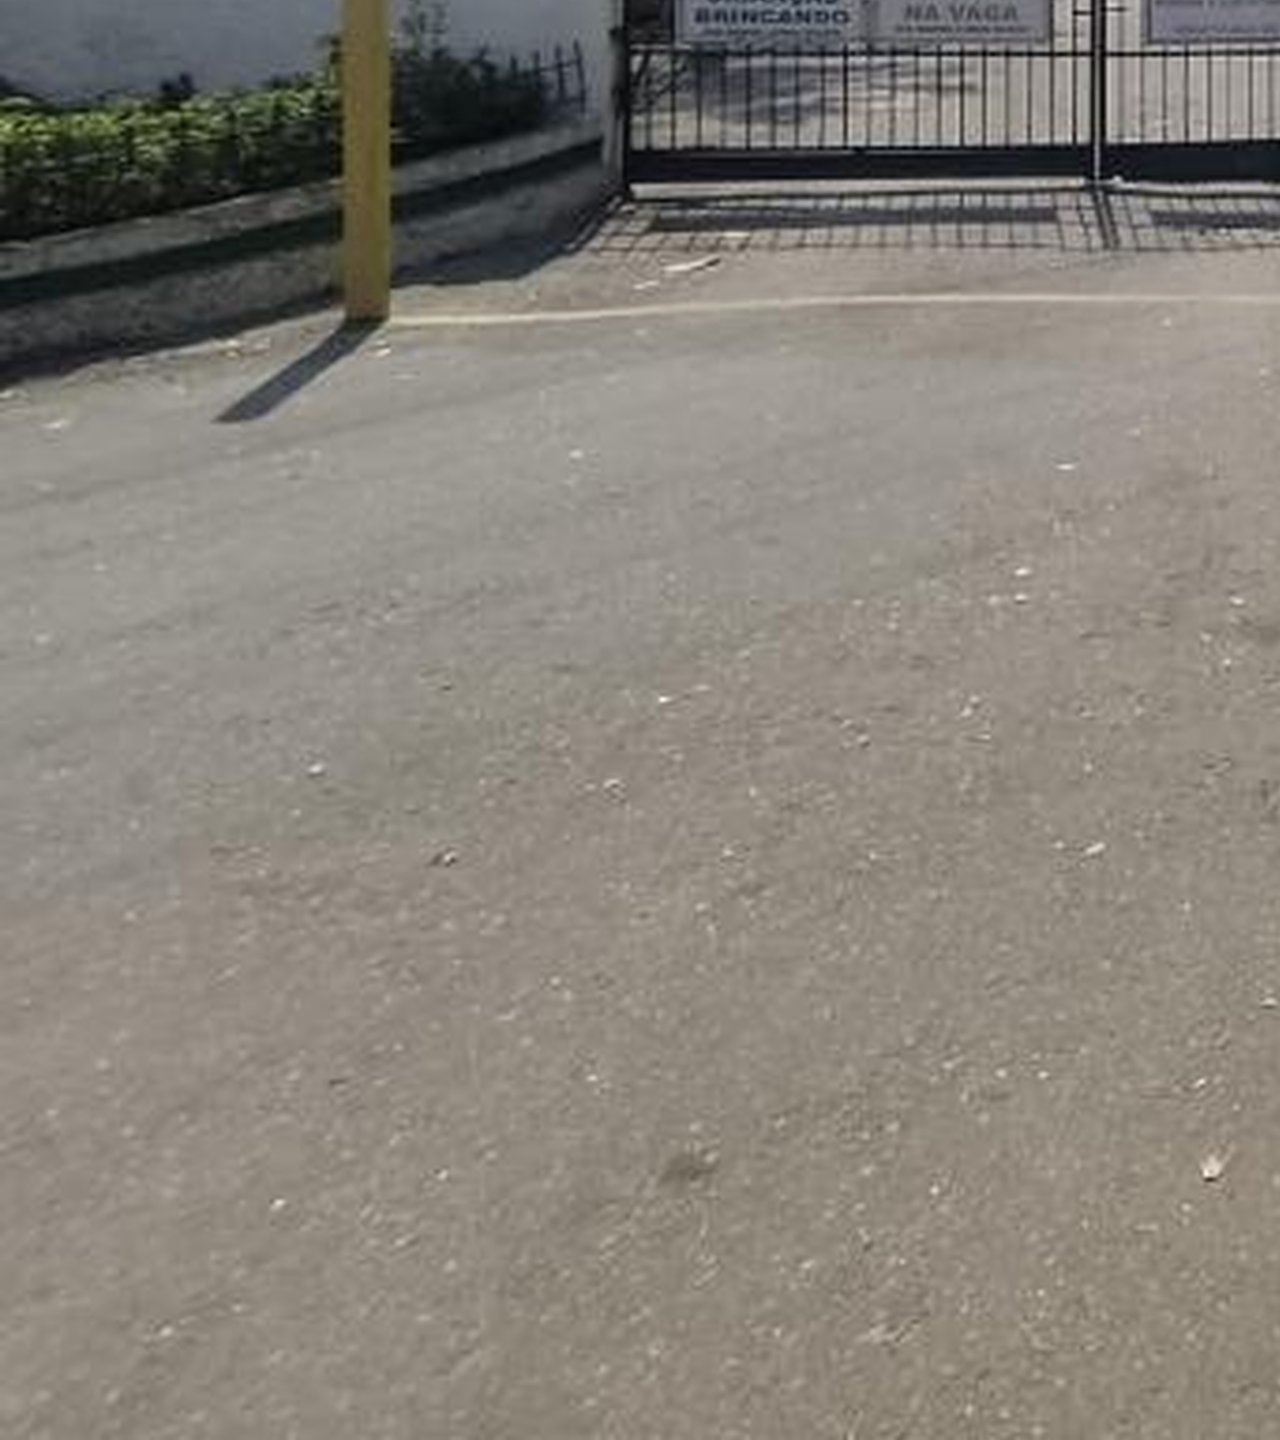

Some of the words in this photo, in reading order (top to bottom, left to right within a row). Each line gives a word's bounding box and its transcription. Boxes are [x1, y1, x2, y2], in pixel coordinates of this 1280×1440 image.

[694, 9, 850, 25] BRINCANDO
[904, 3, 939, 22] NA
[950, 3, 1019, 22] VAGA
